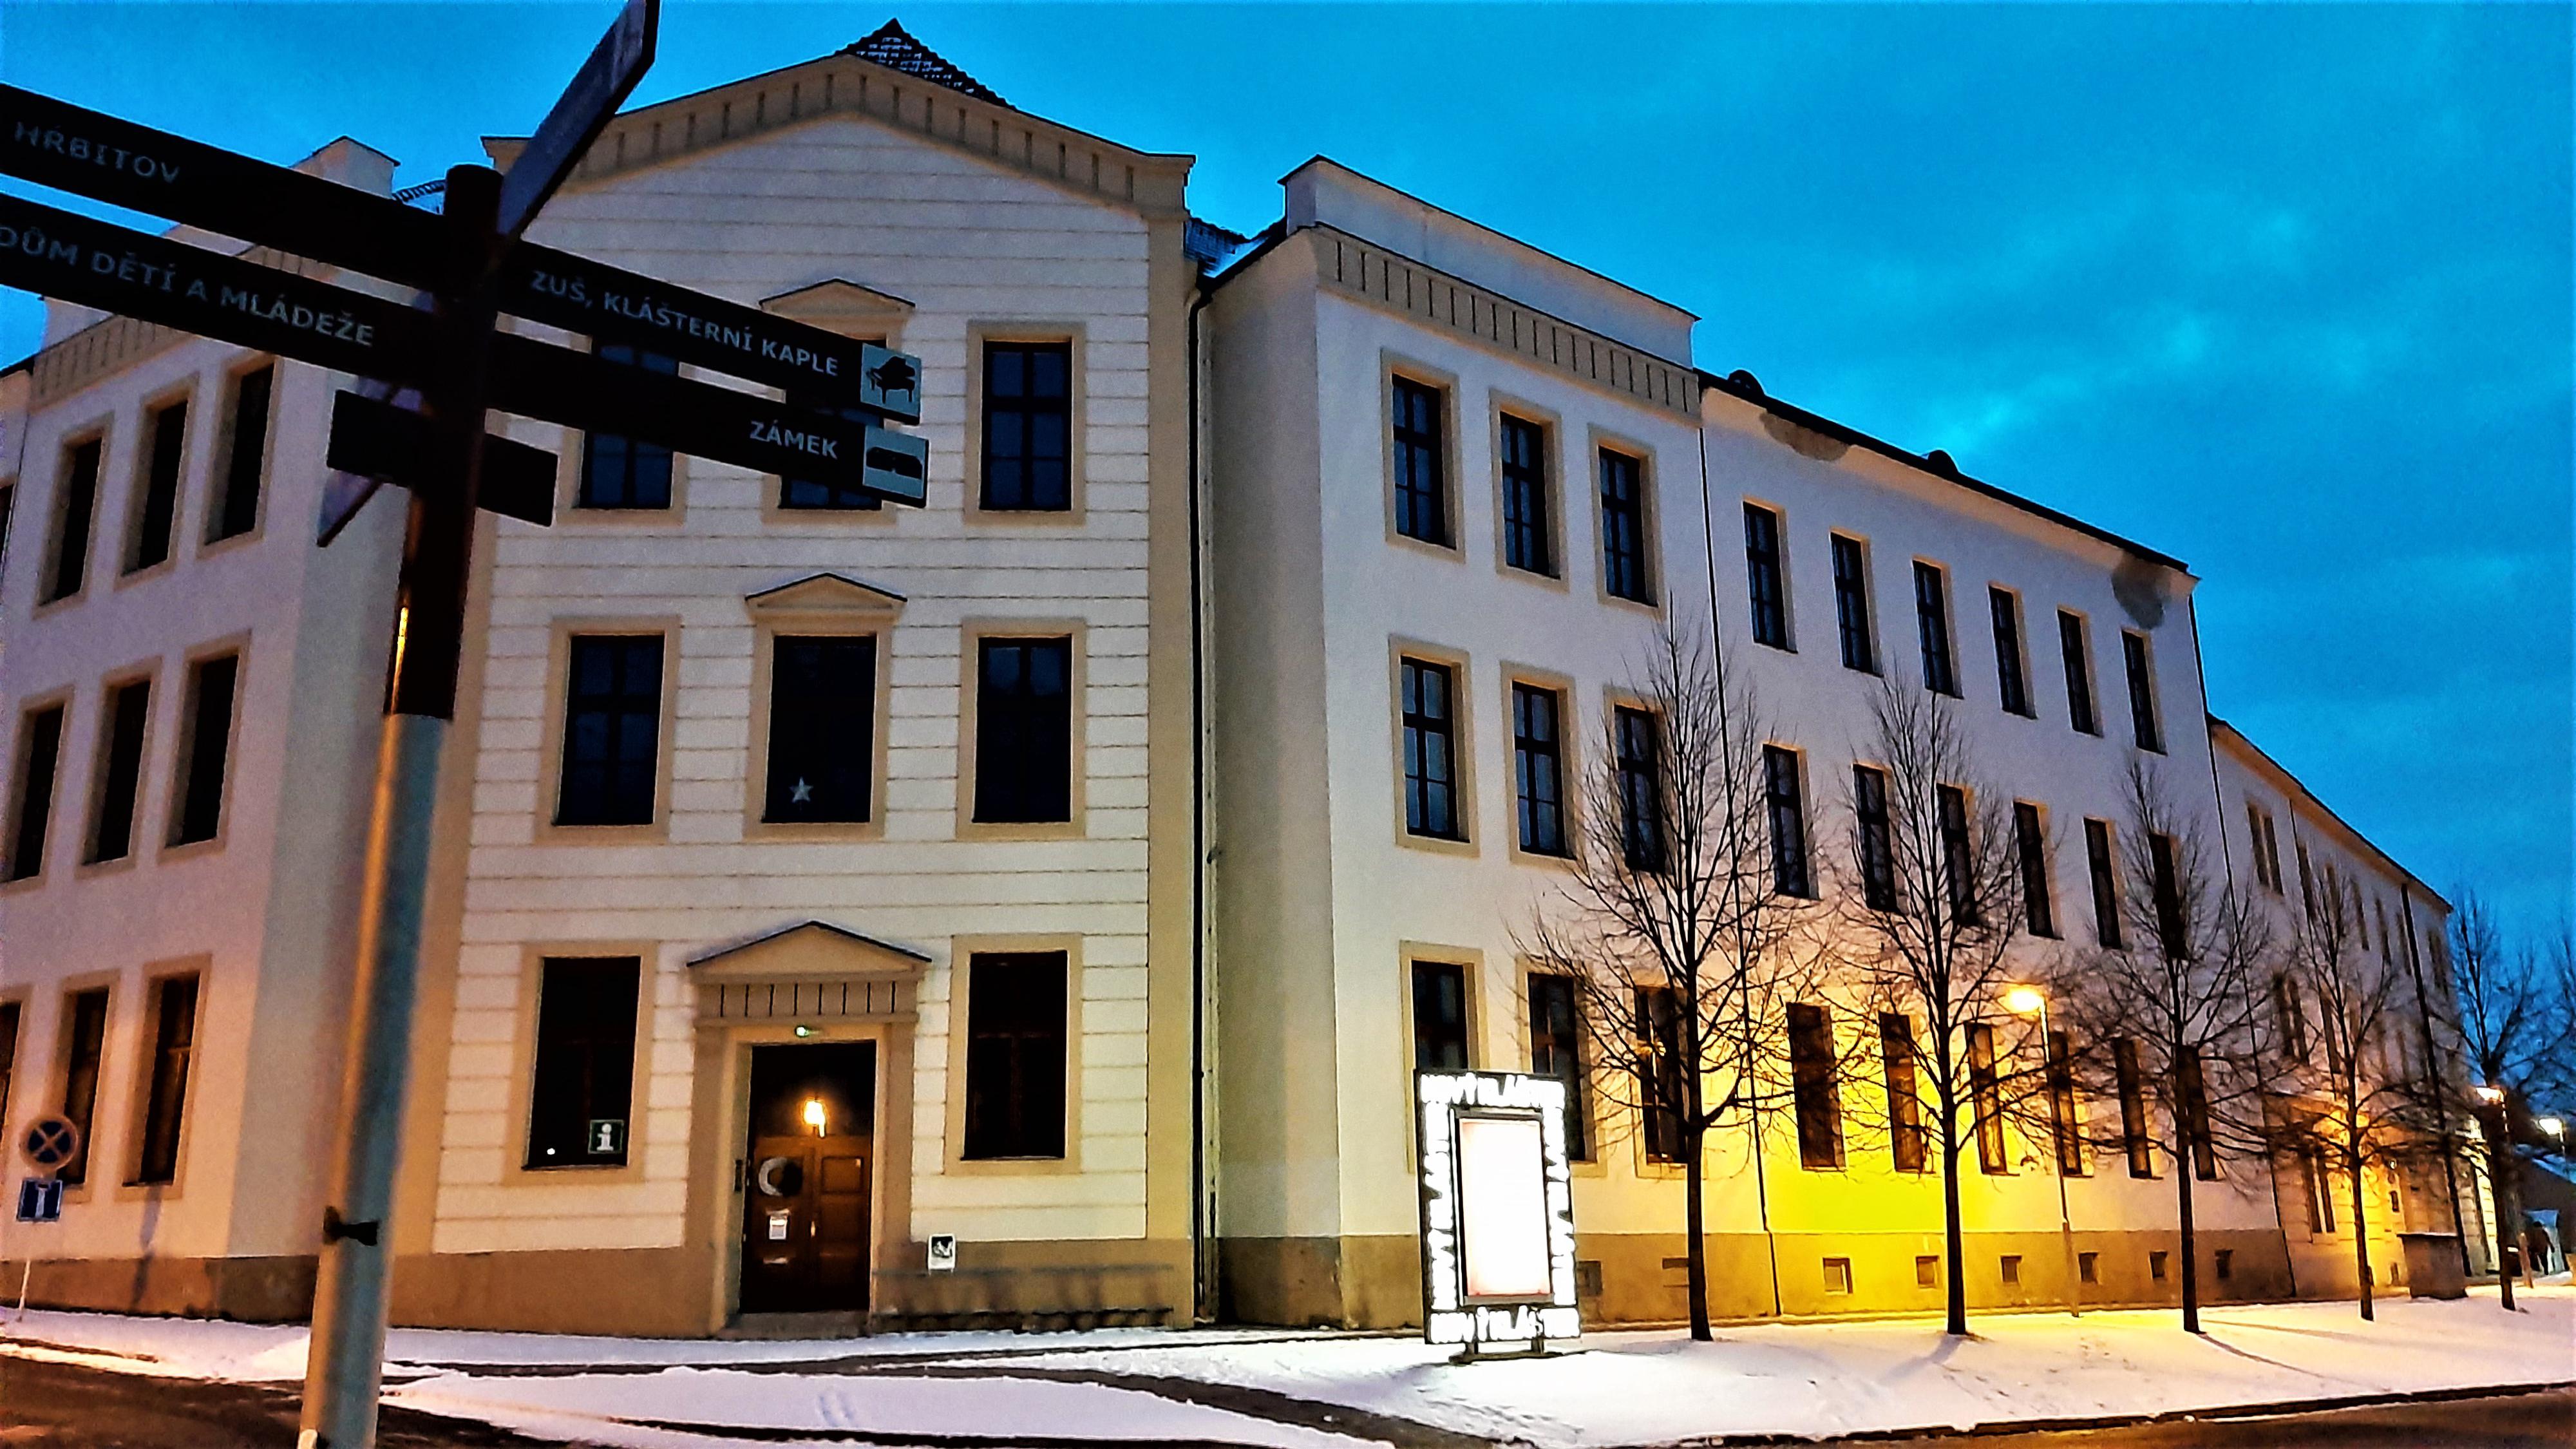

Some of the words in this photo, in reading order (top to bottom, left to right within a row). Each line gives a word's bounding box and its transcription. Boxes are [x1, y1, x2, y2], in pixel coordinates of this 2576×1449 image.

[0, 225, 79, 266] DŮM
[90, 250, 176, 292] DĚTÍ
[185, 277, 208, 302] A
[220, 285, 374, 348] MLÁDEŽE
[531, 269, 593, 308] ZUŠ,
[604, 290, 753, 352] KLÁŠTERNÍ
[761, 338, 838, 377] KAPLE
[749, 419, 838, 459] ZÁMEK
